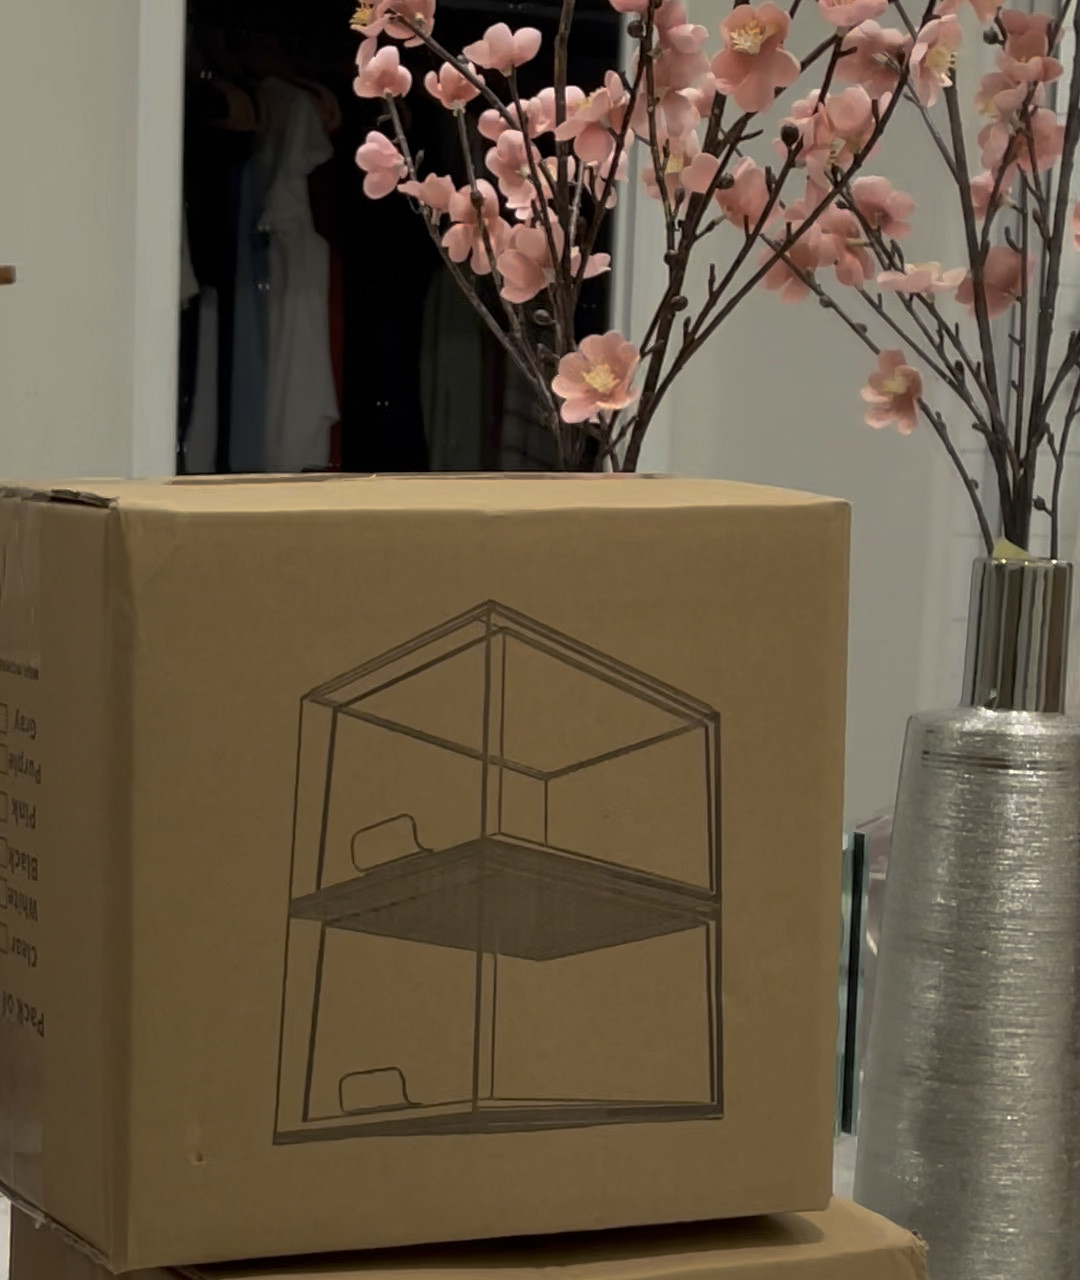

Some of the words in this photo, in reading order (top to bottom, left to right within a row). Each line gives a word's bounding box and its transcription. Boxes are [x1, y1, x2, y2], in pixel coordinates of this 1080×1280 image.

[15, 708, 37, 740] Gray
[8, 751, 42, 785] Purple
[11, 797, 36, 830] Pink
[8, 846, 38, 882] Black
[8, 887, 38, 923] White
[11, 935, 38, 968] Clear
[1, 989, 15, 1018] of
[16, 996, 45, 1039] Pack
